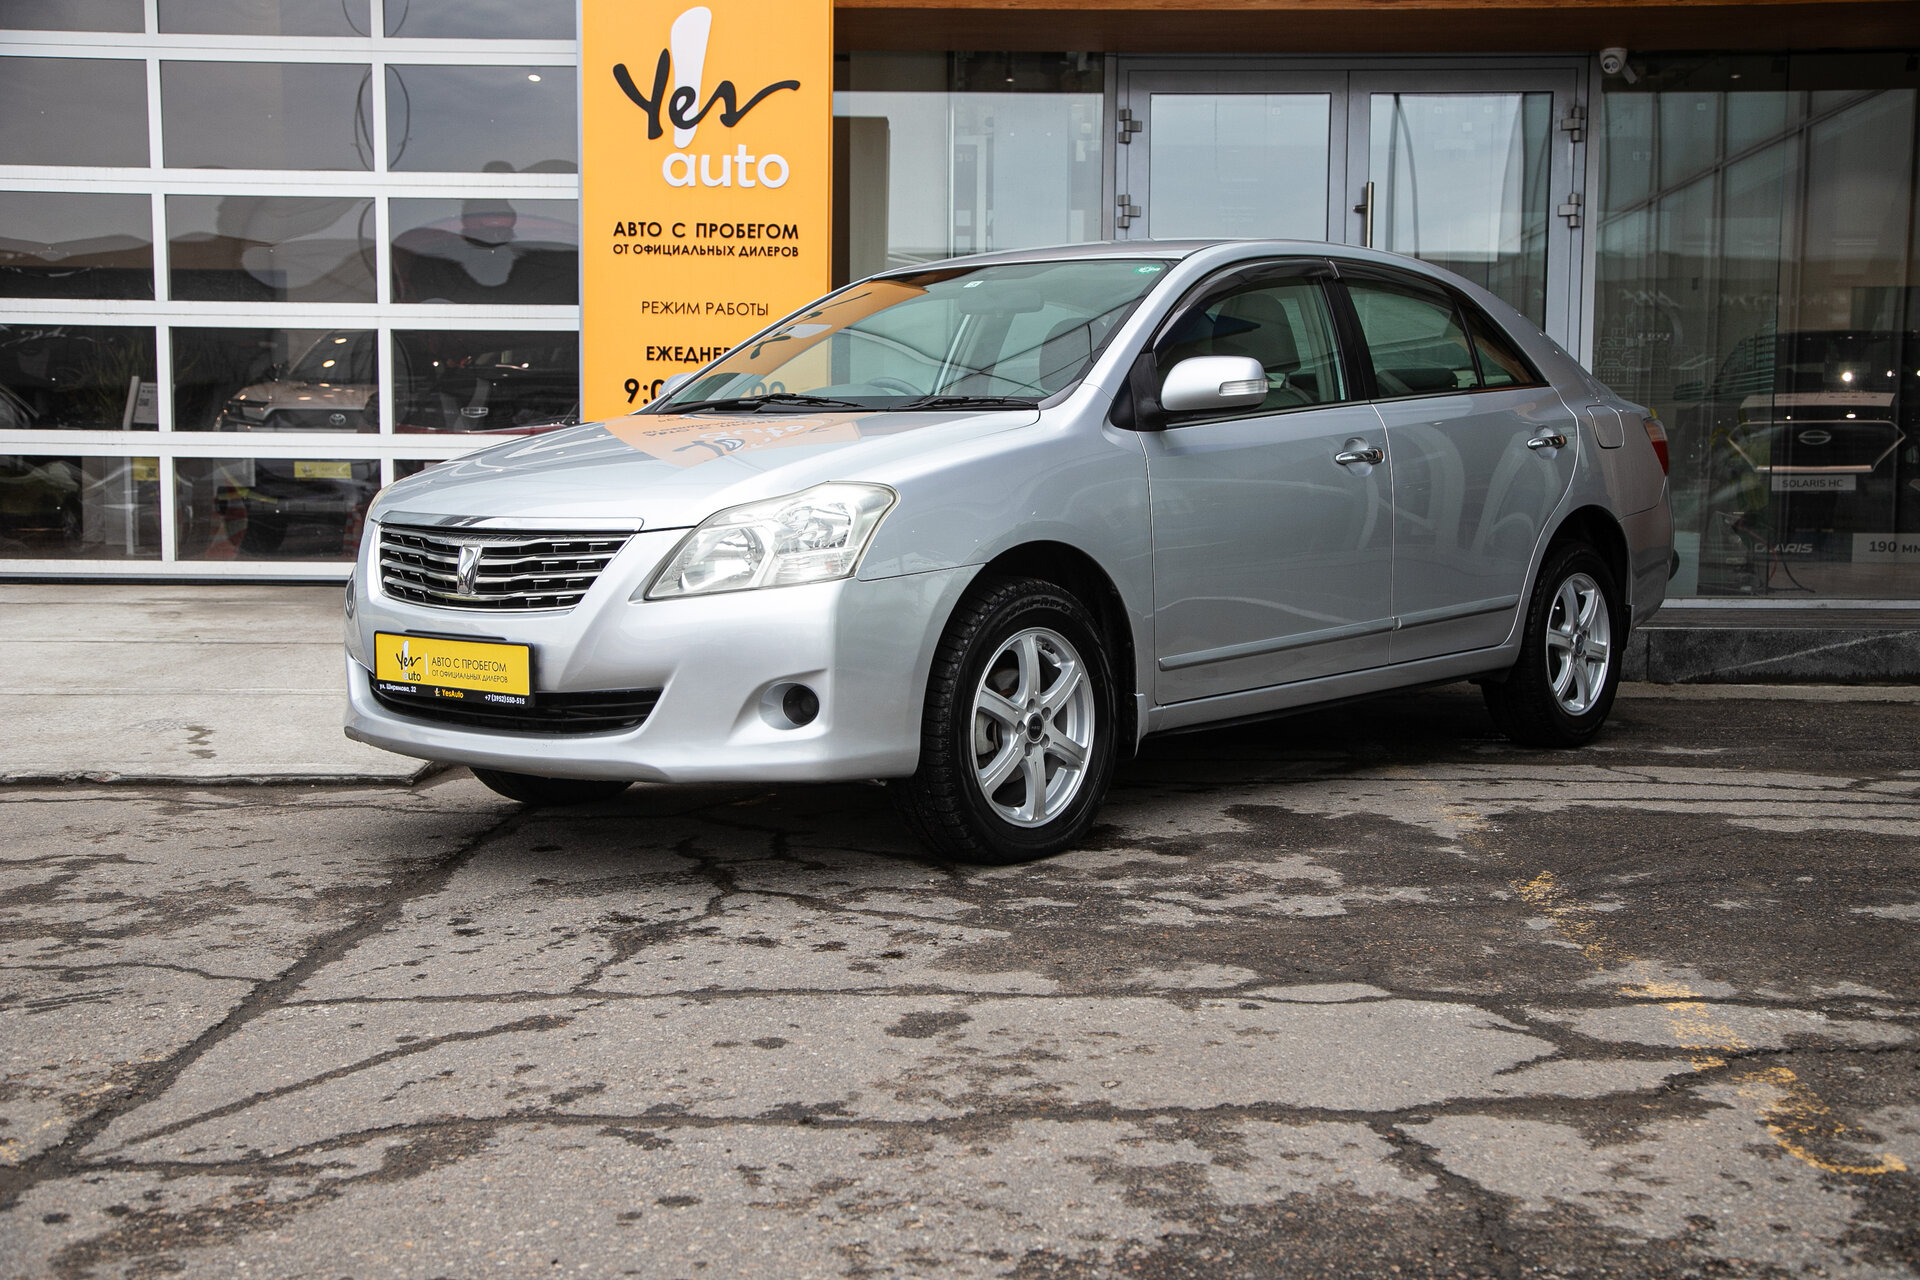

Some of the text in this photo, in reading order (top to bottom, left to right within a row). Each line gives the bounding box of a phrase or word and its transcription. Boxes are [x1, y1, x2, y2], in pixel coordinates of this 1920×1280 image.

[612, 48, 801, 140] Yes
[662, 144, 790, 189] auto
[613, 221, 799, 240] АВТО С ПРОБЕГОМ
[612, 243, 799, 258] ОТ ОФИЦИАЛЬНЫХ ДИЛЕРОВ
[641, 301, 769, 316] РЕЖИМ РАБОТЫ
[1781, 479, 1844, 488] SOLARIS HC
[1868, 540, 1897, 553] 190
[431, 656, 507, 672] АВТО С ПРОБЕГОМ
[402, 671, 422, 682] auto
[431, 669, 508, 683] ОТ ОФИЦИАЛЬНЫХ ДИЛЕРОВ
[441, 688, 464, 699] YesAuto
